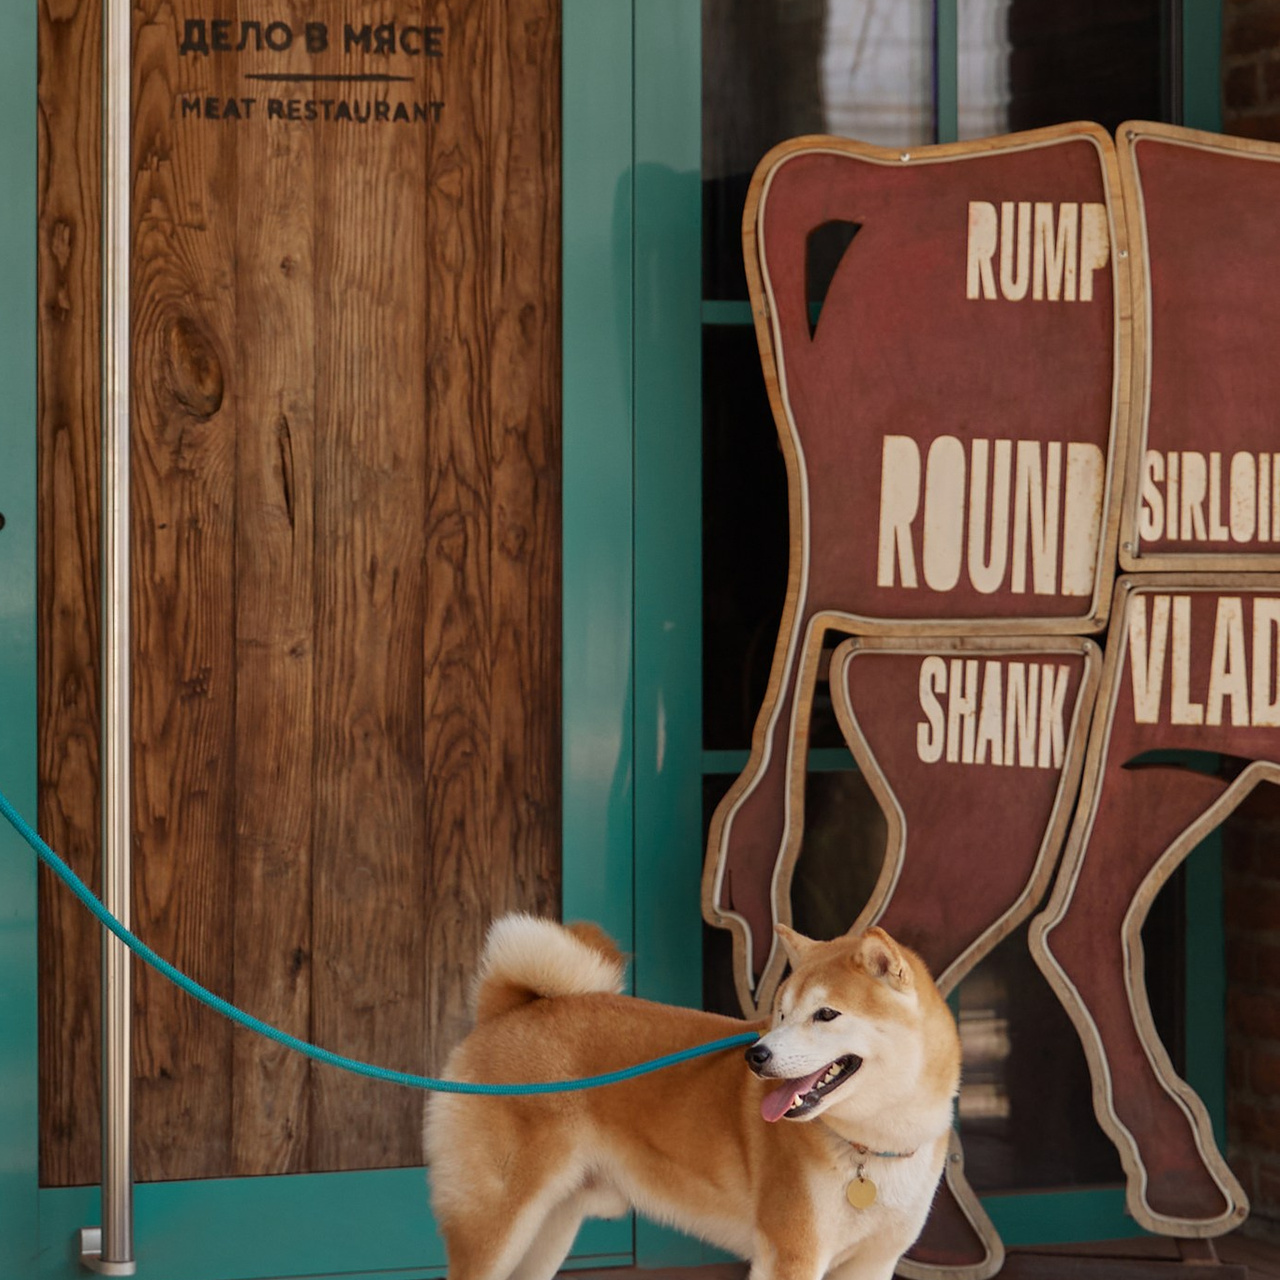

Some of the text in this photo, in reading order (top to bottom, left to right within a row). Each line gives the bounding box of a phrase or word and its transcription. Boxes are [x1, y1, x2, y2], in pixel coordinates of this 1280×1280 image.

[180, 19, 445, 58] ДЕЛО В МЯСЕ
[181, 96, 445, 124] MEAT RESTAURANT
[966, 201, 1110, 302] RUMP
[877, 434, 1105, 597] ROUND
[916, 655, 1070, 769] SHANK
